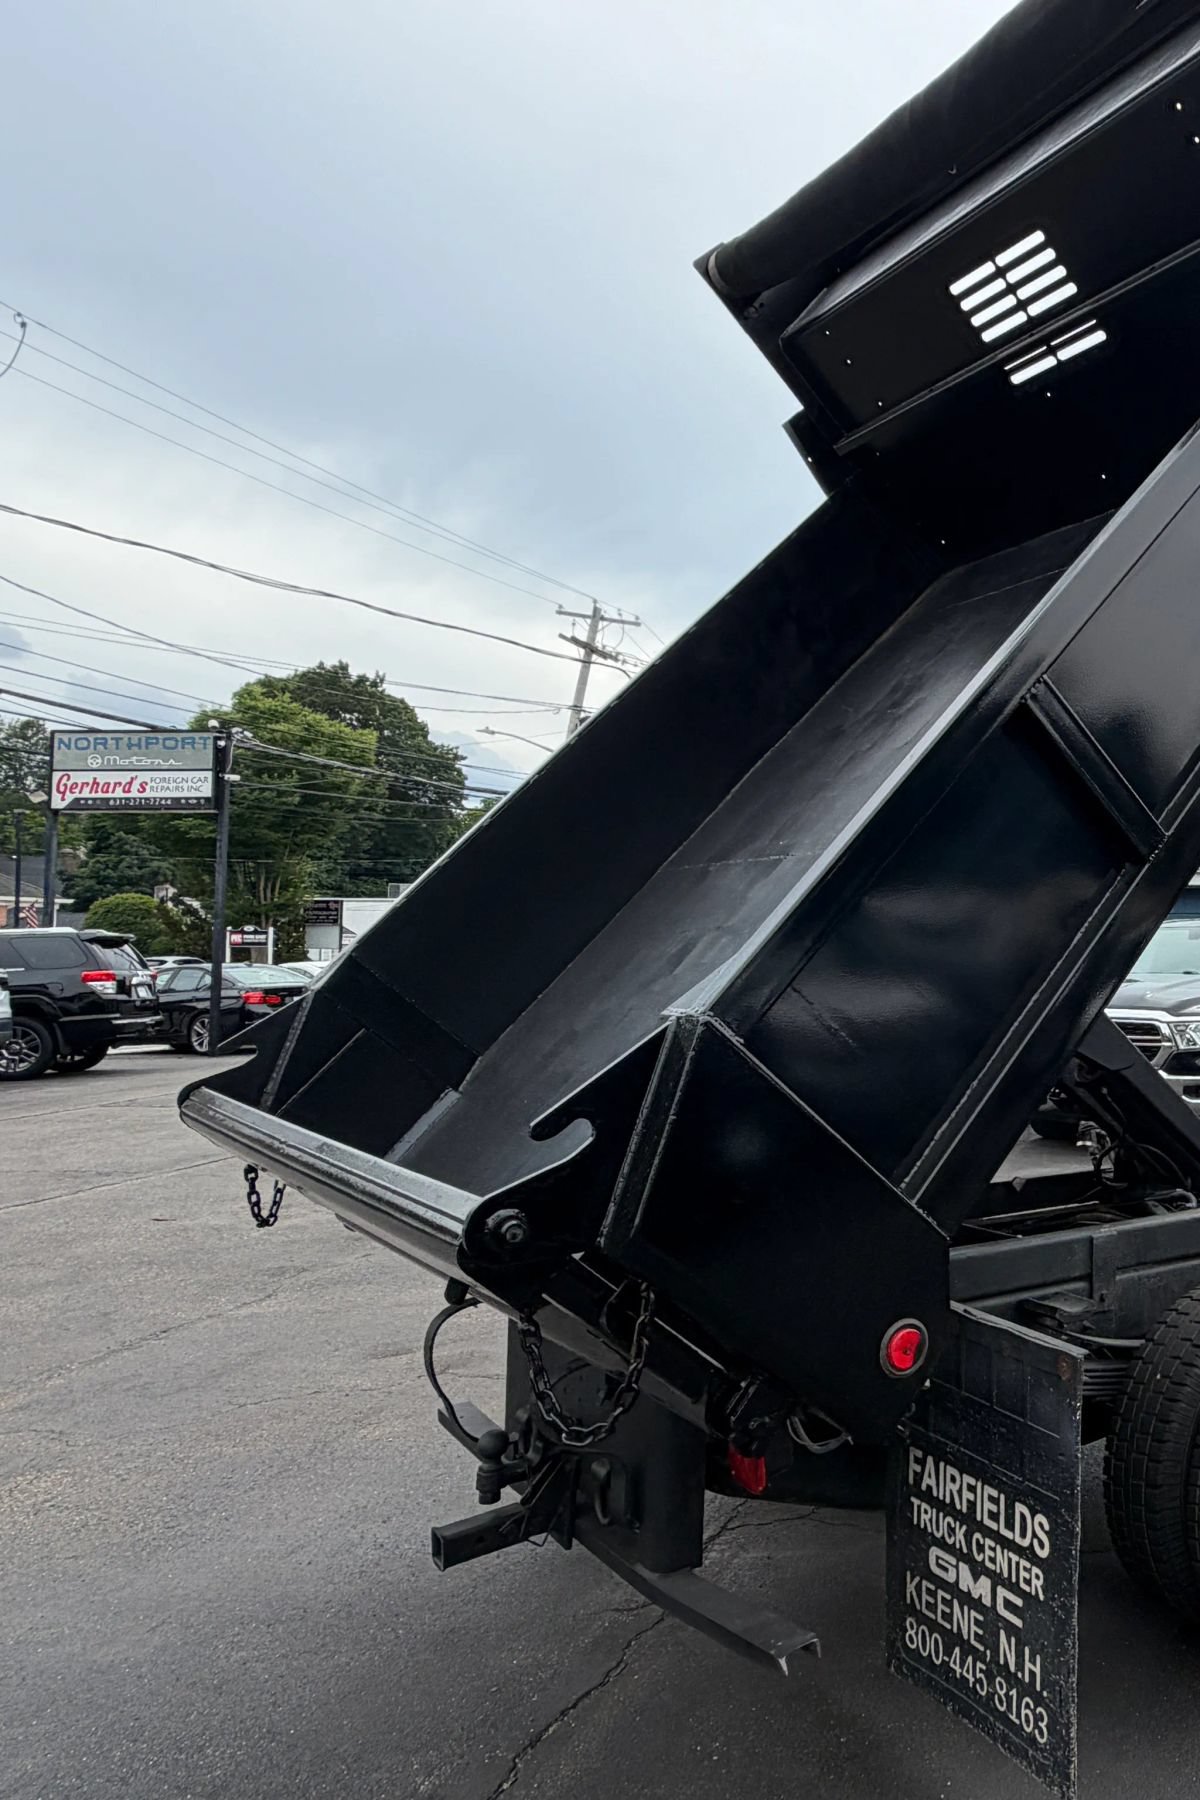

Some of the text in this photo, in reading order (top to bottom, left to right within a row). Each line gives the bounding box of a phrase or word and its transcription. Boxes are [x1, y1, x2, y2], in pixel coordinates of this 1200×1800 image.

[57, 737, 211, 750] NORTHPORT
[104, 755, 183, 766] Motors
[55, 773, 149, 801] Gerhard's
[149, 785, 203, 793] REPAIRS INC
[150, 776, 209, 784] FOREIGN CAR
[908, 1447, 1050, 1559] FAIRFIELDS
[910, 1496, 1045, 1601] TRUCK CENTER
[928, 1546, 1023, 1629] GMC
[906, 1570, 1048, 1698] KEENE, N.H.
[905, 1616, 1048, 1744] 800-445-8163
